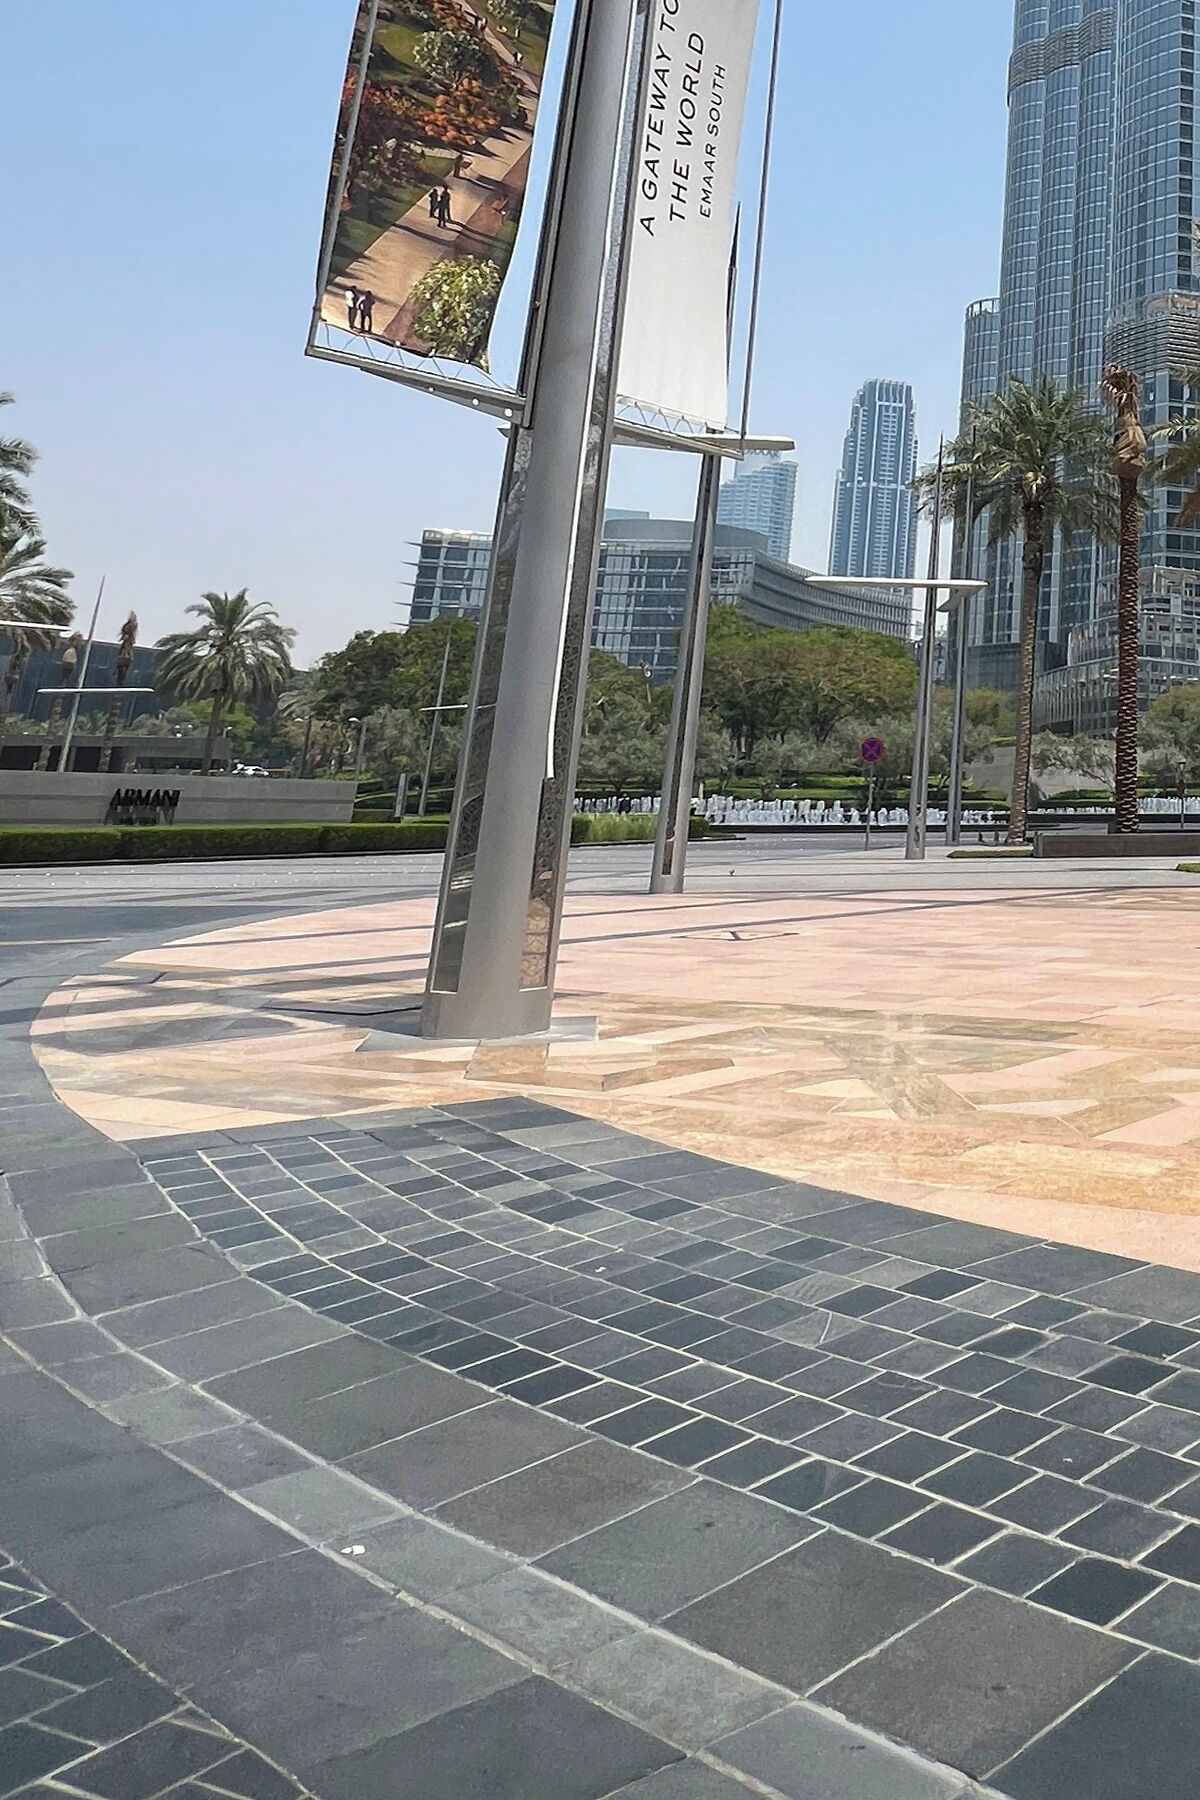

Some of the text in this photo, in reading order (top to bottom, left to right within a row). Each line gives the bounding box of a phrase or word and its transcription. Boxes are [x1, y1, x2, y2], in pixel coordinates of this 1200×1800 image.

[642, 42, 672, 201] GATEWAY
[670, 32, 704, 222] THE WORLD
[700, 64, 726, 219] EMAAR SOUTH
[640, 216, 656, 237] A
